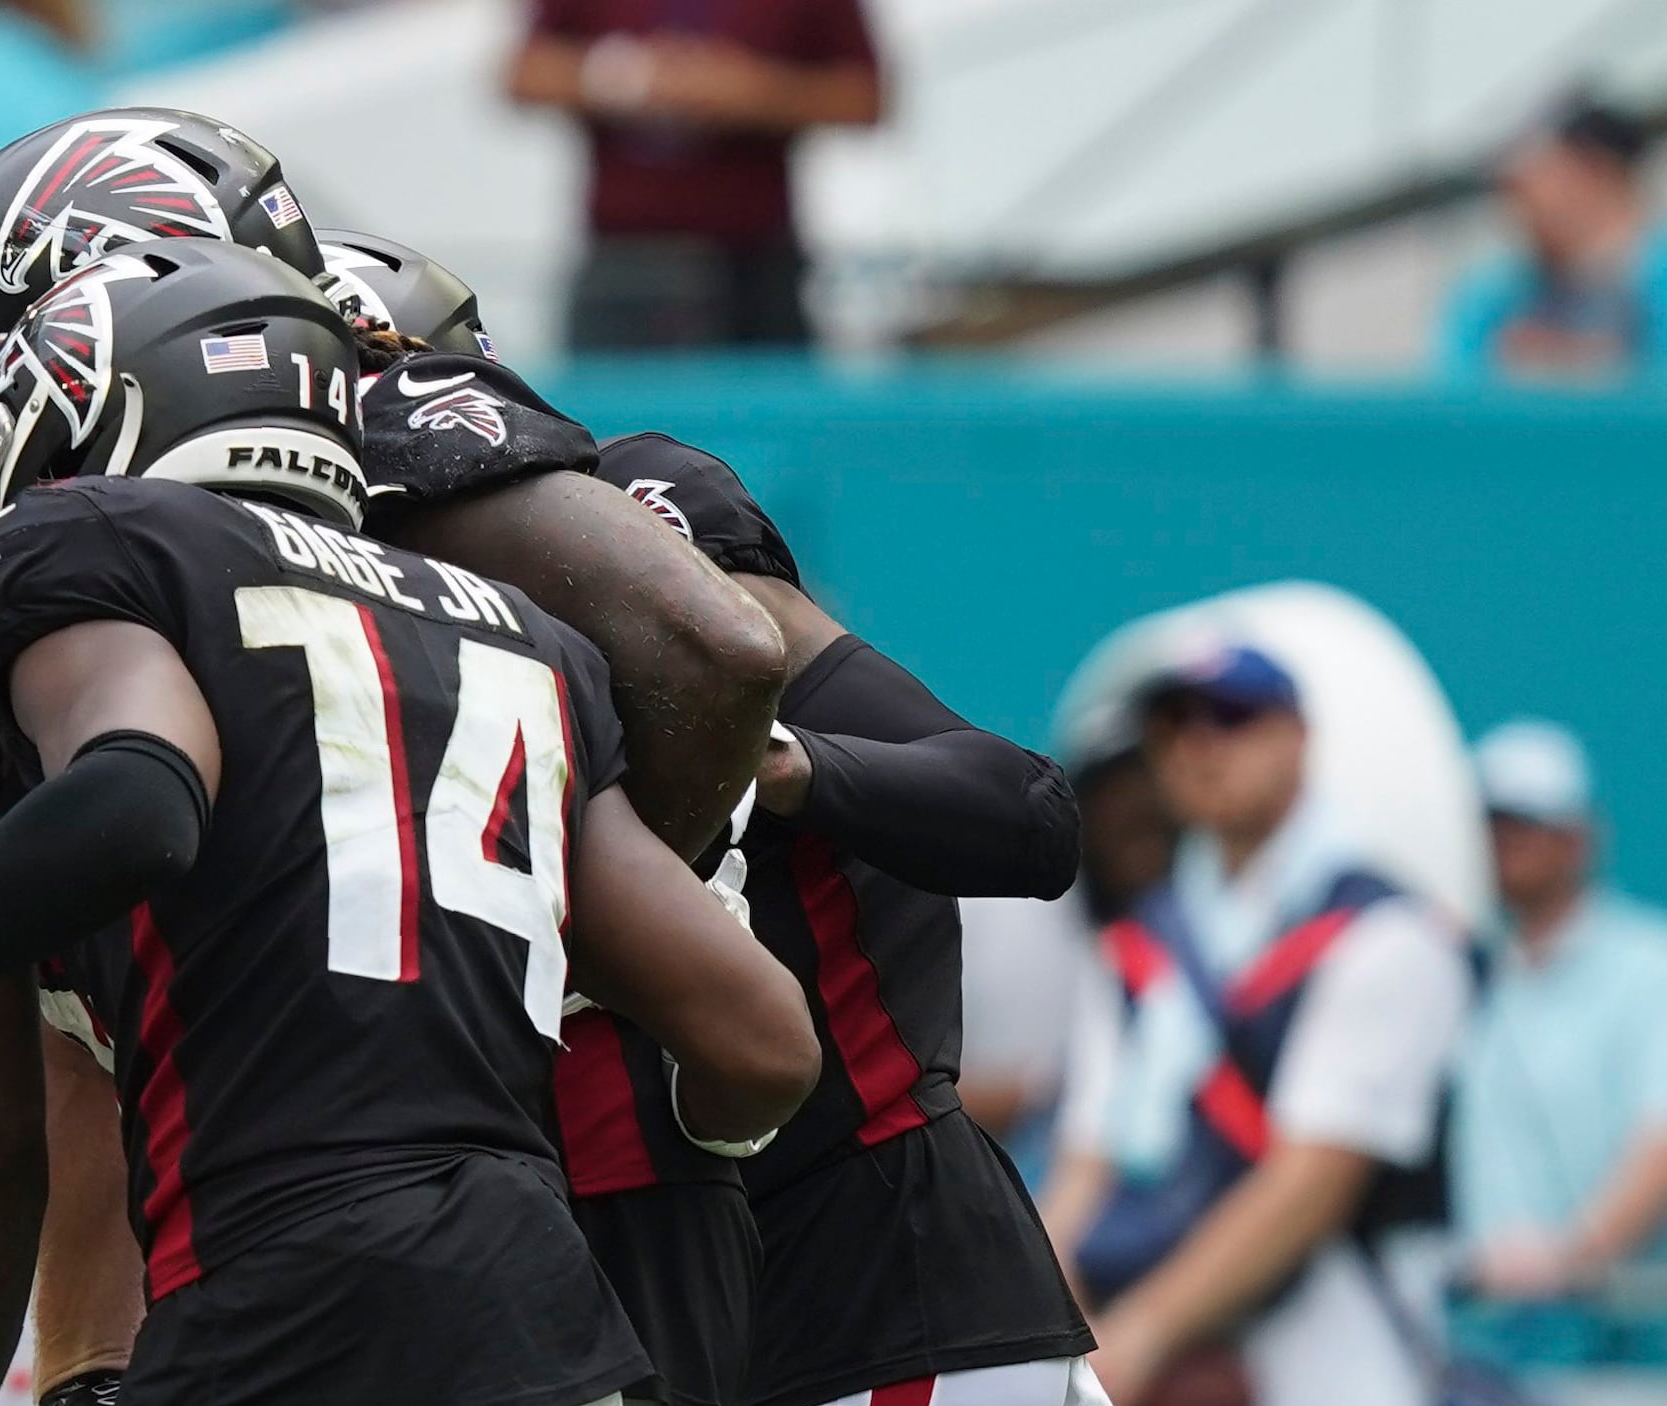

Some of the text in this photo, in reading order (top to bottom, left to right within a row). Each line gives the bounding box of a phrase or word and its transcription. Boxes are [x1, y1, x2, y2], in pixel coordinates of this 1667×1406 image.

[290, 352, 347, 425] 14
[424, 557, 523, 634] JR
[233, 585, 575, 1046] 14
